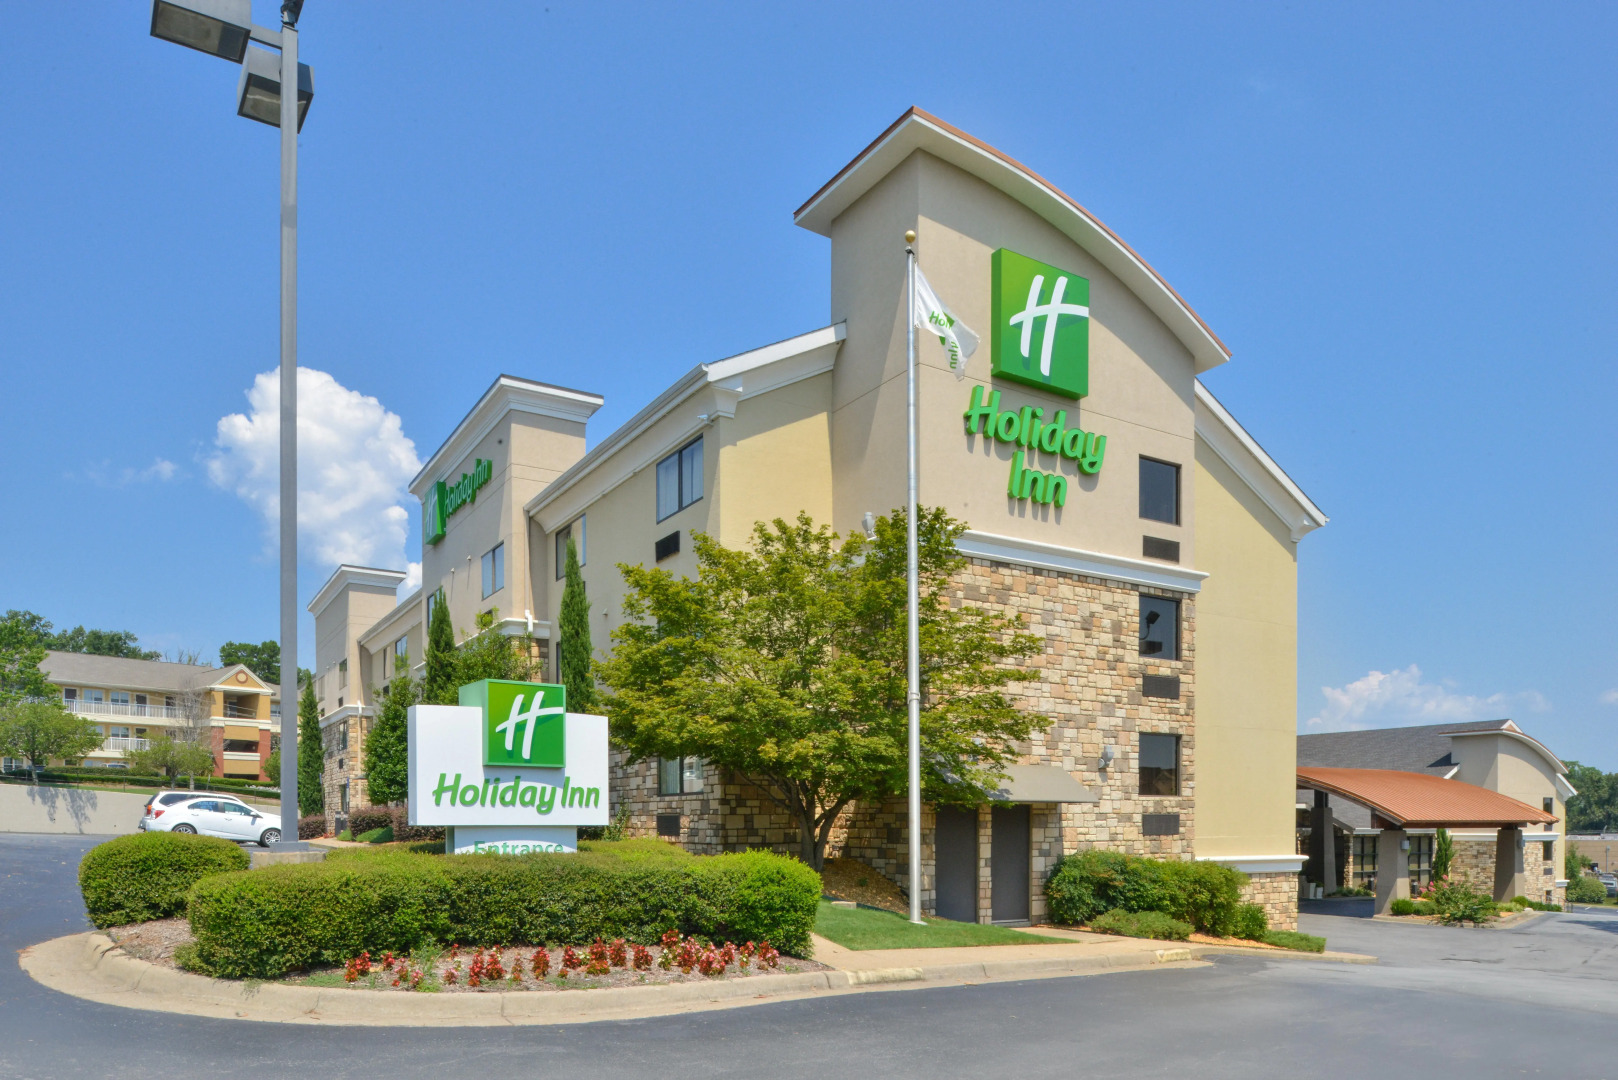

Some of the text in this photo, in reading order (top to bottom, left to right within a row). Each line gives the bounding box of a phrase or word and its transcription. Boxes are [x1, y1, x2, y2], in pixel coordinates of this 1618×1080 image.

[1009, 274, 1090, 377] H
[963, 385, 1107, 476] Holiday
[444, 458, 493, 519] Holiday Inn
[1007, 450, 1068, 508] Inn
[495, 690, 564, 760] H
[432, 773, 600, 815] Holiday Inn
